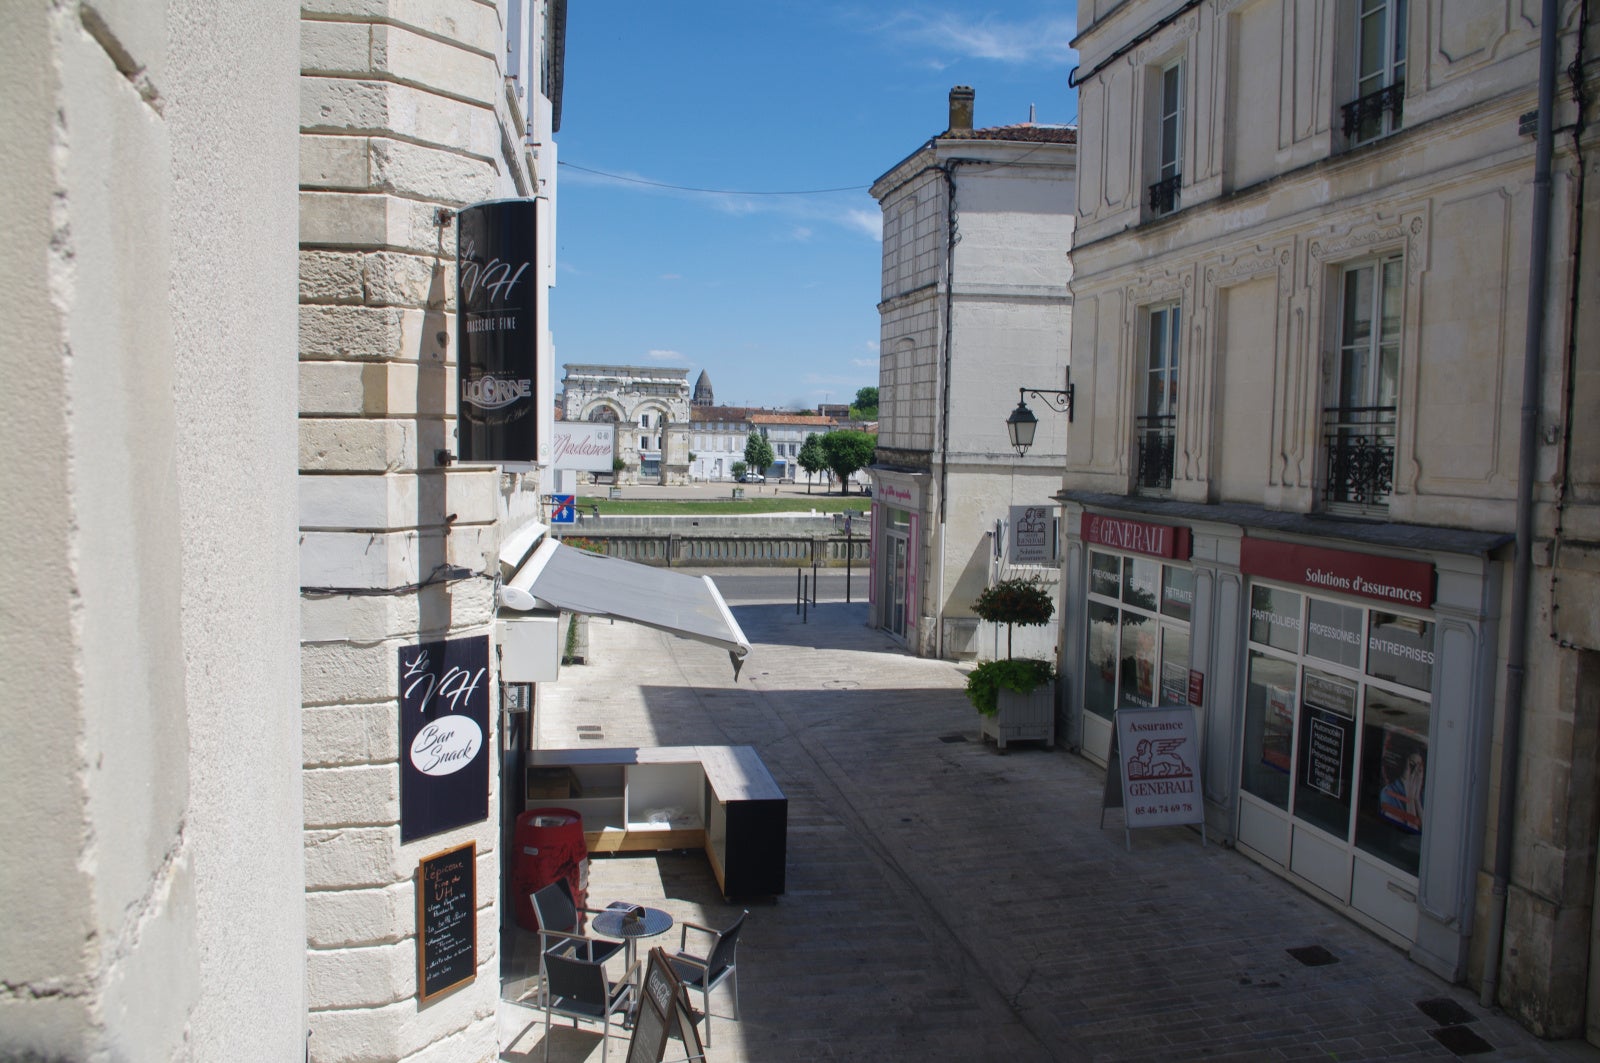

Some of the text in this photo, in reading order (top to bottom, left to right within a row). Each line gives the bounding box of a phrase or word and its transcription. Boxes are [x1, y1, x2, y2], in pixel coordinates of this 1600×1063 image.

[461, 258, 531, 303] VH
[466, 315, 516, 333] BRASSERIE FINE
[462, 375, 532, 404] LICORNE
[1100, 519, 1165, 554] GENERALI
[1165, 586, 1193, 602] RETRAITE
[1305, 567, 1422, 603] Solutions d'assurances
[1252, 608, 1301, 630] PARTICULIERS
[1309, 622, 1361, 646] PROFESSIONNELS
[404, 650, 430, 679] Le
[1369, 636, 1435, 666] ENTREPRISES
[404, 666, 486, 713] VH
[415, 724, 455, 754] Bar
[1129, 720, 1184, 733] Assurance
[423, 740, 472, 772] Snack
[1129, 779, 1194, 798] GENERALI
[1135, 803, 1192, 816] 05 46 74 69 78
